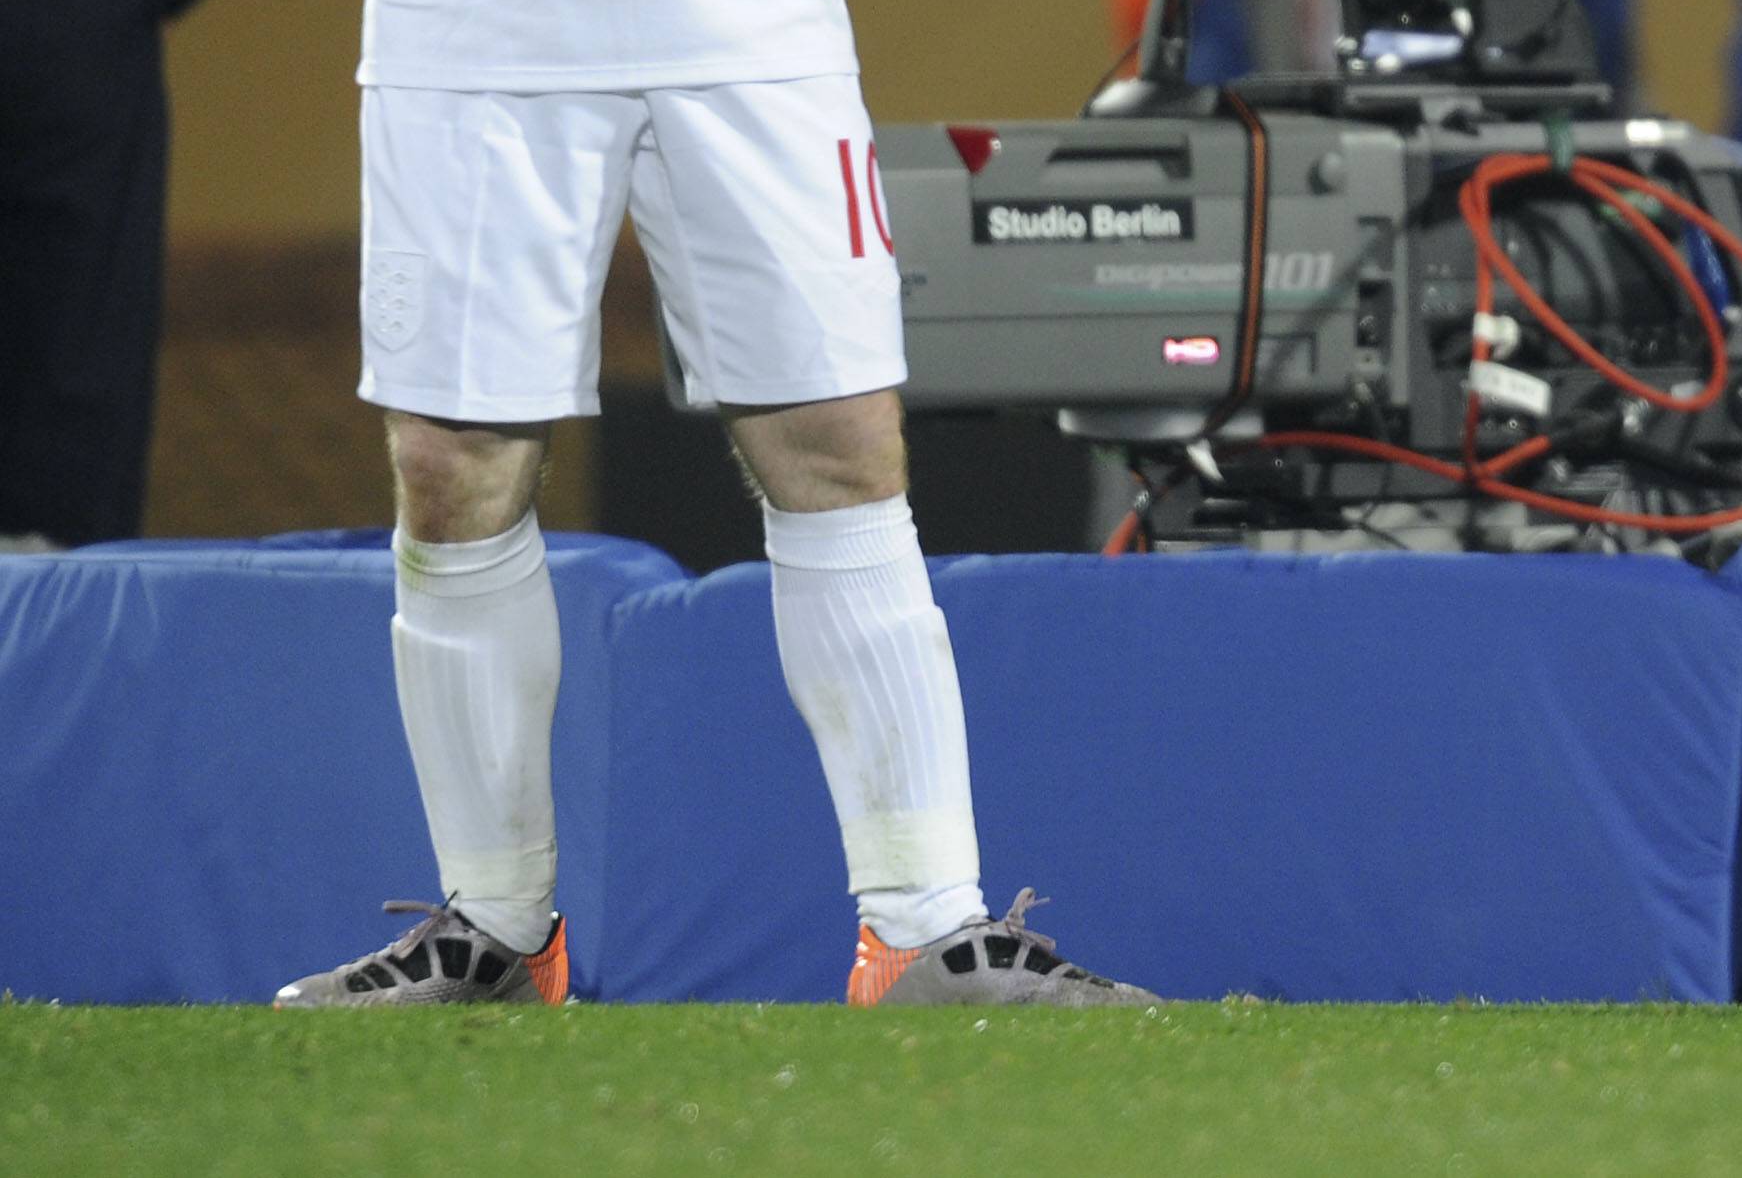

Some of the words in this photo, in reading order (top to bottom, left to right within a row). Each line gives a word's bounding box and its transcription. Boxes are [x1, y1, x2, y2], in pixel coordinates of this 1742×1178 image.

[988, 205, 1087, 240] Studio
[1091, 203, 1182, 238] Berlin
[1263, 252, 1335, 291] 101
